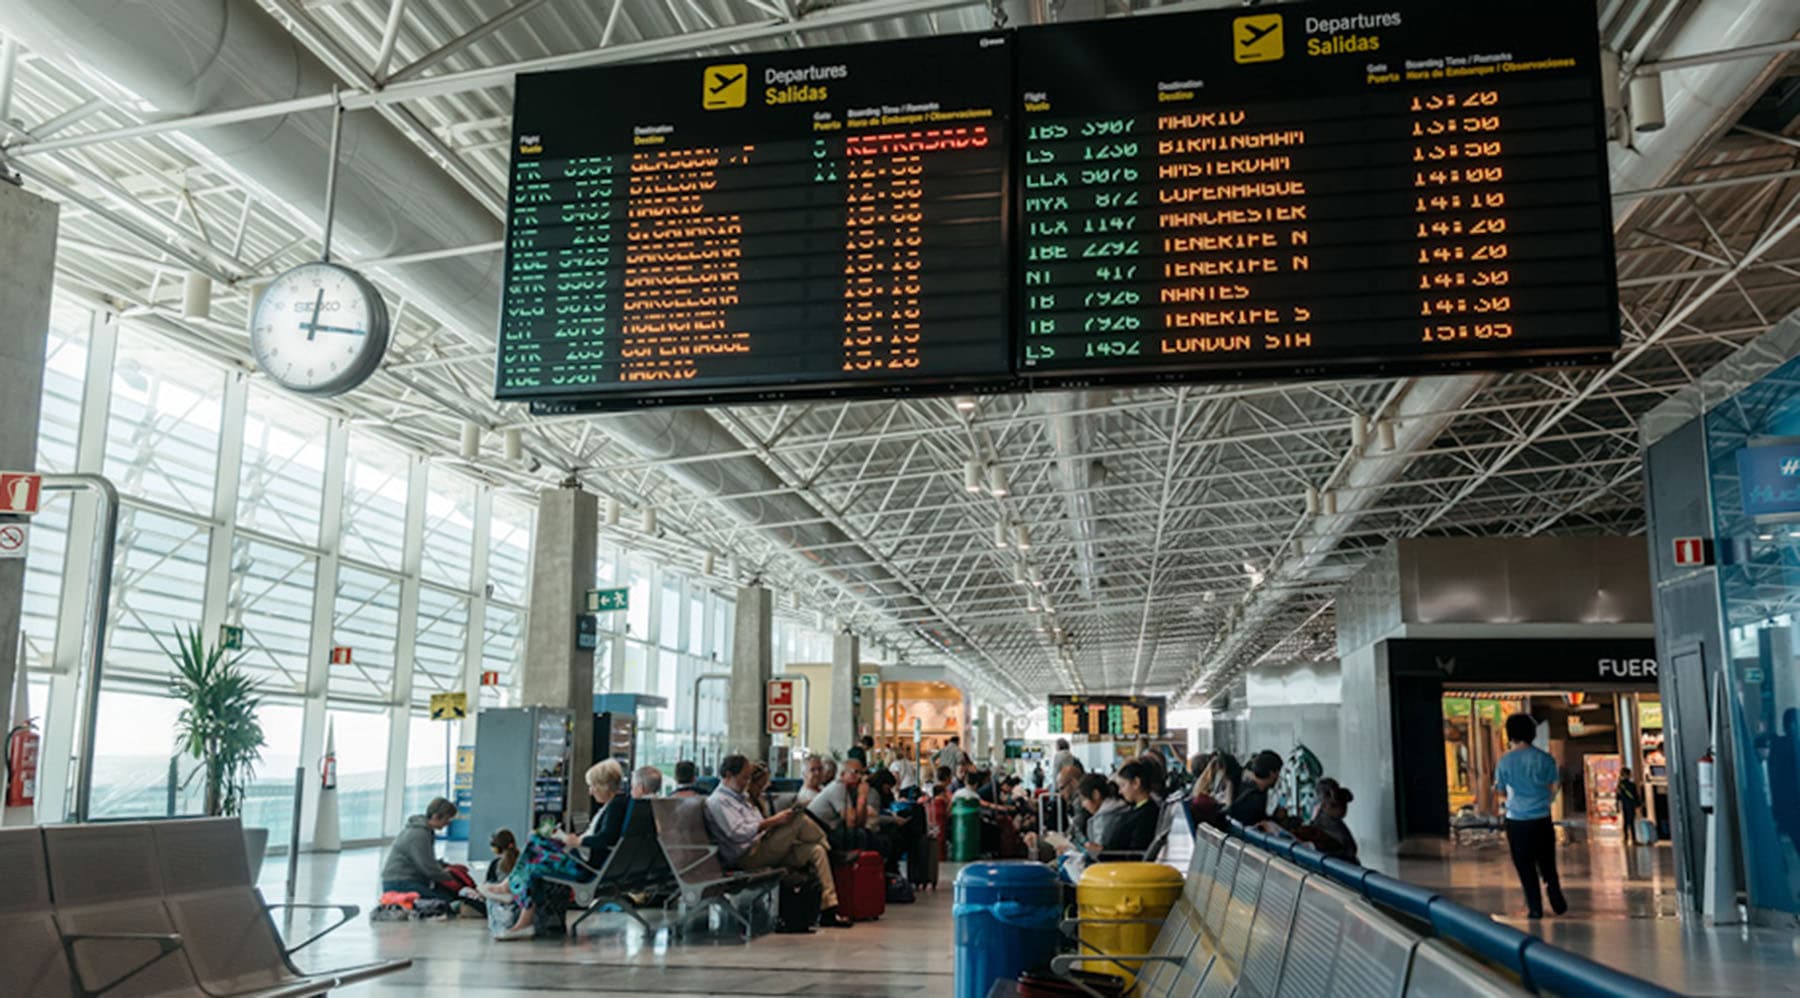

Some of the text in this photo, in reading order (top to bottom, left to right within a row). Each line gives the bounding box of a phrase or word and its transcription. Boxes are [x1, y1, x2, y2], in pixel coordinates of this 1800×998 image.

[1305, 12, 1401, 35] Departures
[1307, 34, 1380, 56] Salidas
[765, 64, 848, 85] Departures
[1366, 64, 1388, 73] Gate
[1405, 59, 1444, 70] Boarding
[1445, 57, 1466, 66] Time
[1431, 69, 1444, 78] de
[1366, 73, 1400, 84] Puerta
[765, 85, 828, 105] Salidas
[1158, 91, 1195, 102] Destino
[813, 121, 842, 131] Puerta
[1029, 126, 1067, 139] IBS
[1159, 112, 1244, 129] MADRID
[1412, 92, 1497, 110] 13:20
[1027, 151, 1053, 163] LS
[1159, 132, 1303, 154] BIRMINGHAM
[1413, 117, 1499, 135] 13:50
[1027, 173, 1068, 187] LLX
[1160, 157, 1289, 177] AMSTERDAM
[1414, 142, 1500, 160] 13:50
[1027, 197, 1068, 211] MYX
[1160, 182, 1304, 202] COPENHAGUE
[1416, 168, 1502, 185] 14:00
[1160, 206, 1306, 226] MANCHESTER
[1417, 193, 1504, 211] 14:10
[1030, 246, 1067, 259] IBE
[1165, 234, 1276, 251] TENERIFE
[1292, 231, 1307, 244] N
[1418, 219, 1505, 236] 14:20
[1027, 271, 1050, 284] NT
[1166, 259, 1277, 276] TENERIFE
[1293, 257, 1308, 269] N
[1420, 245, 1507, 262] 14:20
[1161, 286, 1249, 302] NANTES
[1420, 271, 1508, 288] 14:30
[294, 302, 341, 312] SEKO
[1166, 310, 1278, 327] TENERIFE
[1295, 308, 1309, 320] S
[1422, 297, 1510, 314] 14:30
[1027, 346, 1054, 358] LS
[1162, 336, 1250, 352] LONDON
[1424, 324, 1512, 340] 15:05
[1598, 658, 1657, 677] FUER
